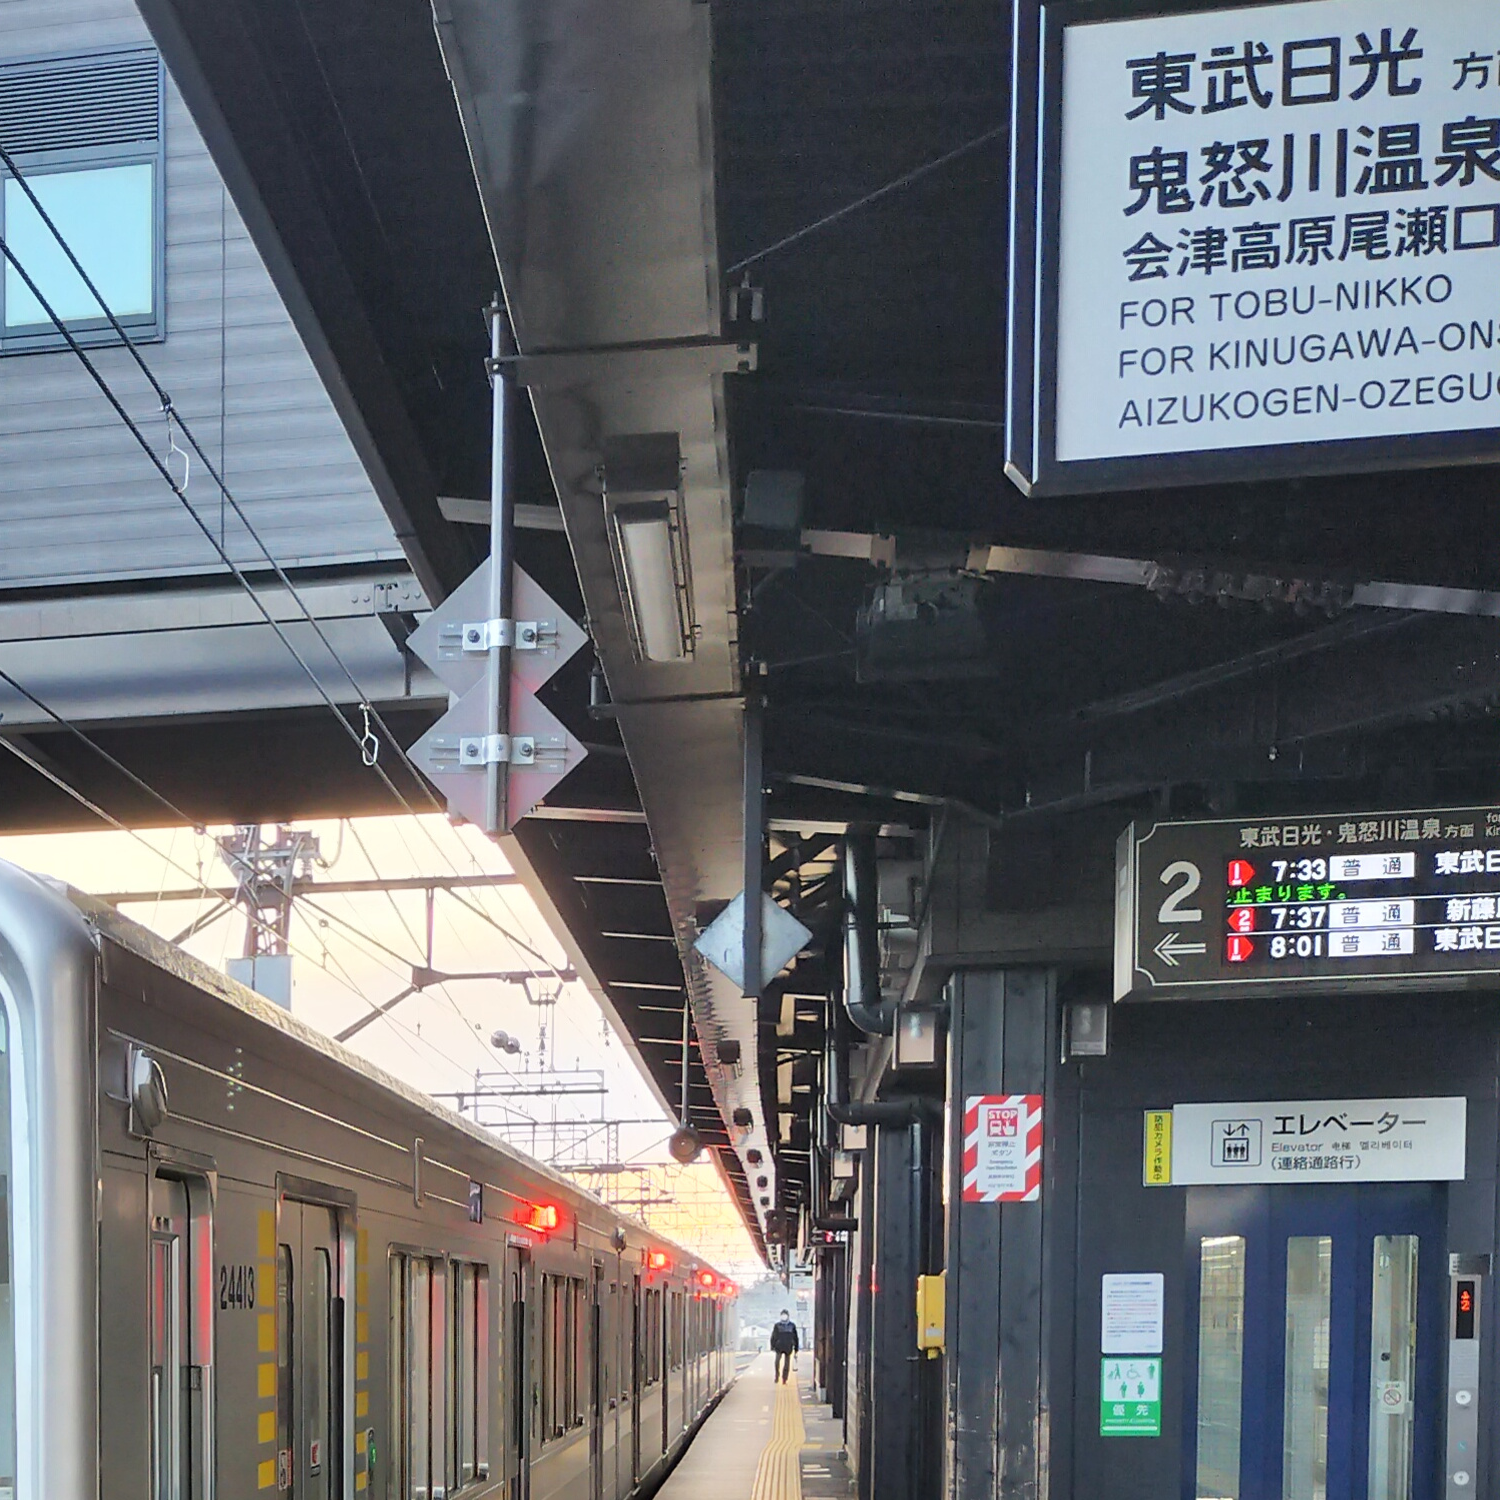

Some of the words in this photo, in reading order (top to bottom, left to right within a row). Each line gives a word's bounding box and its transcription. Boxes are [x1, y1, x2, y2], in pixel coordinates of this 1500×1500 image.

[1125, 27, 1424, 121] 東武日光
[1453, 50, 1500, 90] 方
[1123, 116, 1500, 217] 鬼怒川温泉
[1122, 203, 1500, 282] 会津高原尾瀬口
[1119, 297, 1195, 330] FOR
[1210, 273, 1453, 322] TOBU-NIKKO
[1118, 345, 1195, 379] FOR
[1209, 319, 1500, 371] KINUGAWA-ON
[1118, 371, 1500, 429] AIZUKOGEN-OZEGU
[1444, 823, 1474, 839] 方面
[1158, 861, 1202, 923] 2
[1271, 858, 1326, 882] 7:33
[1342, 857, 1402, 877] 普通
[1238, 909, 1251, 927] 2
[1271, 906, 1326, 929] 7:37
[1341, 904, 1402, 924] 普通
[1446, 897, 1500, 921] 新藤
[1270, 935, 1322, 958] 8:01
[1341, 932, 1402, 953] 普通
[988, 1110, 1018, 1120] STOP
[1272, 1111, 1427, 1136] エレベーター
[1271, 1141, 1324, 1153] Elevator
[220, 1264, 255, 1310] 24413
